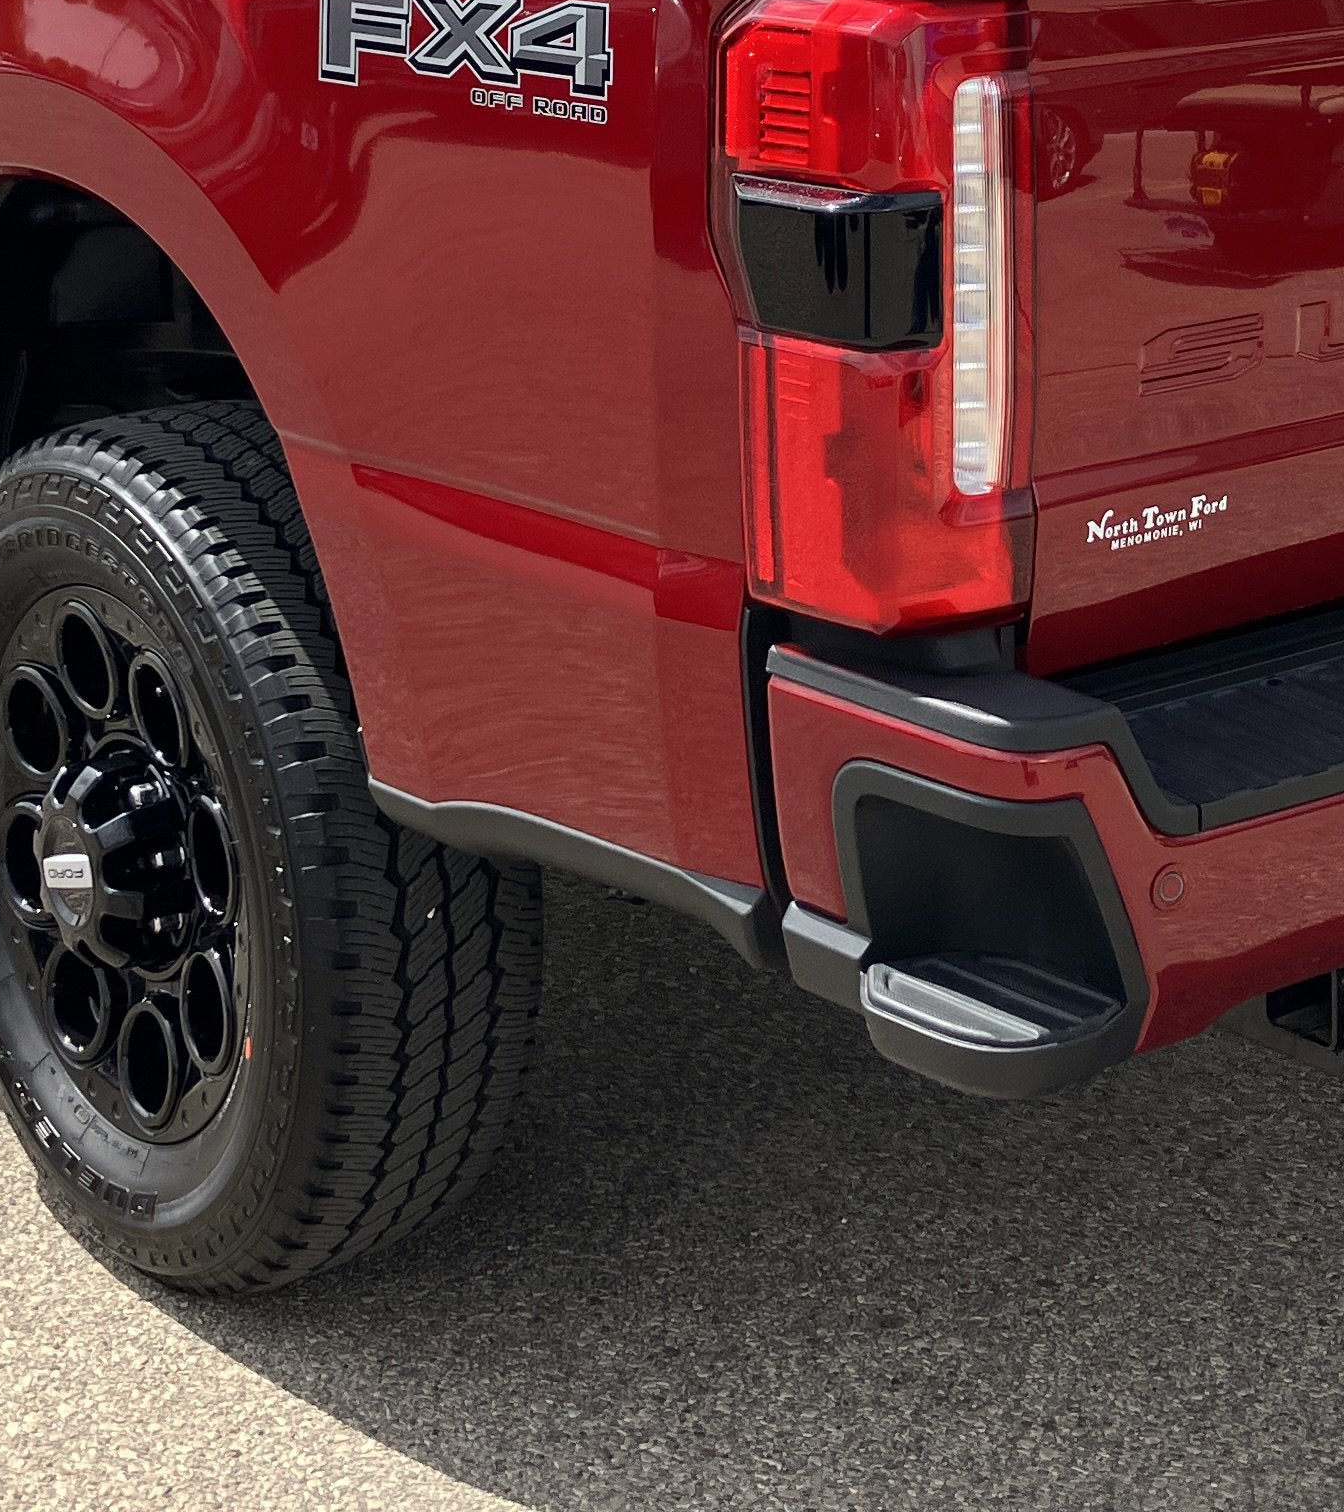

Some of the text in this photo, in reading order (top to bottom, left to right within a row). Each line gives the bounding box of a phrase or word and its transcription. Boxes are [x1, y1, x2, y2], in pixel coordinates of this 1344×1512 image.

[470, 88, 607, 124] OFF ROAD
[1086, 494, 1228, 543] North Town Ford
[1110, 519, 1203, 550] MENOMONIE, WI
[48, 868, 84, 879] FORD
